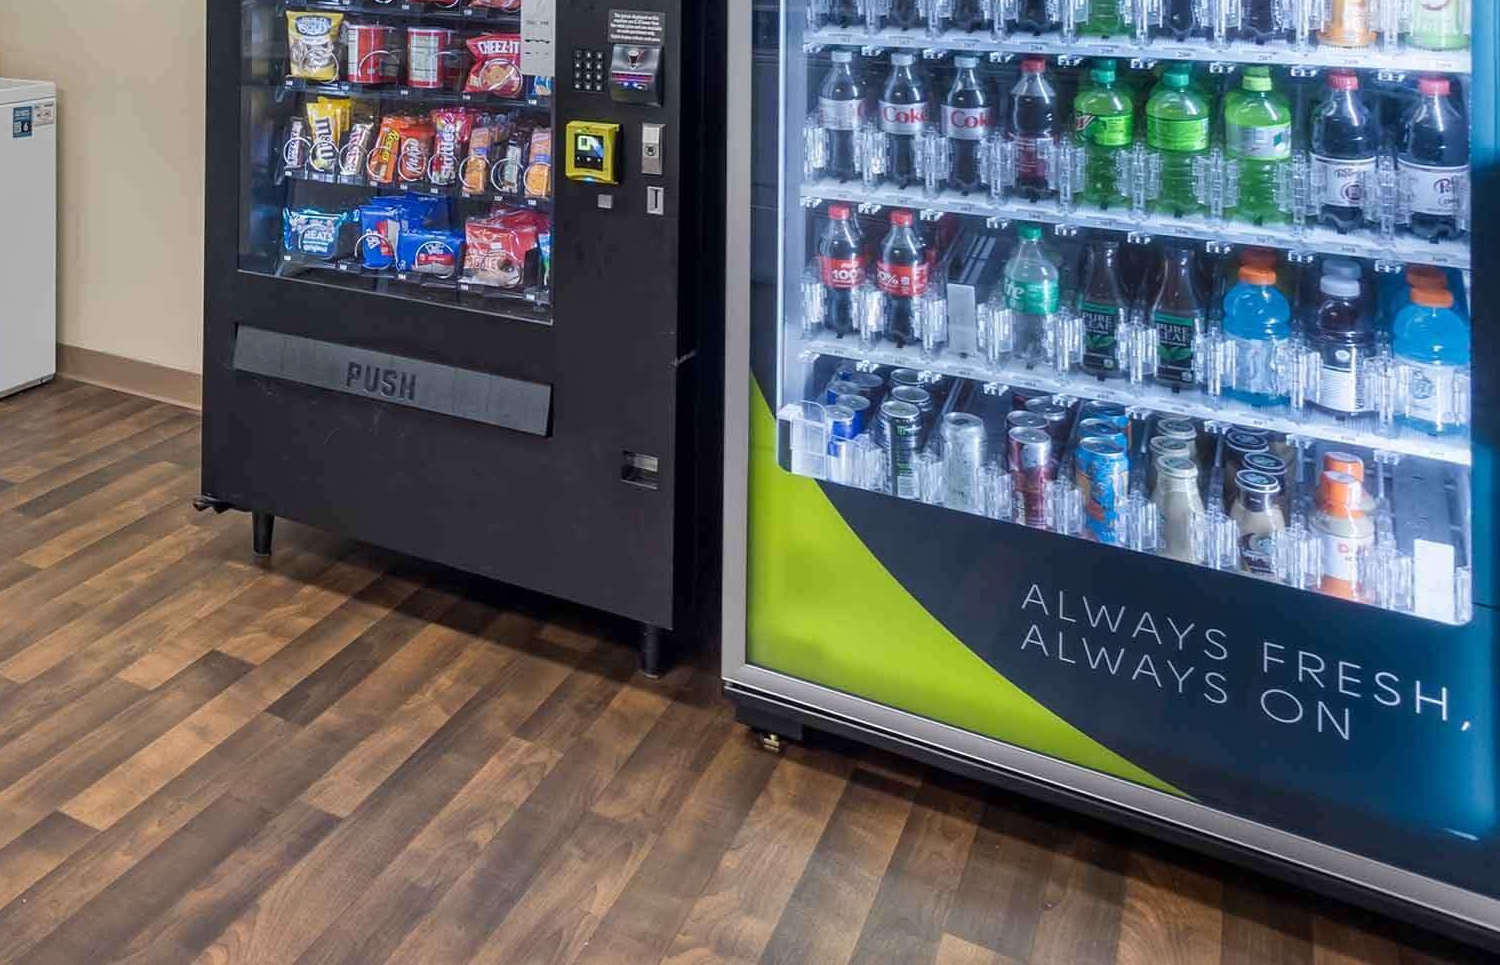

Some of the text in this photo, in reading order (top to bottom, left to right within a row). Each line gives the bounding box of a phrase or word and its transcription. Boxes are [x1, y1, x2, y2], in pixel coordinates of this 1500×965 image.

[883, 106, 930, 125] Coke
[1082, 311, 1112, 324] PURE
[346, 361, 417, 401] PUSH
[1021, 583, 1471, 732] ALWAYS FRESH,
[1020, 624, 1350, 741] ALWAYS ON
